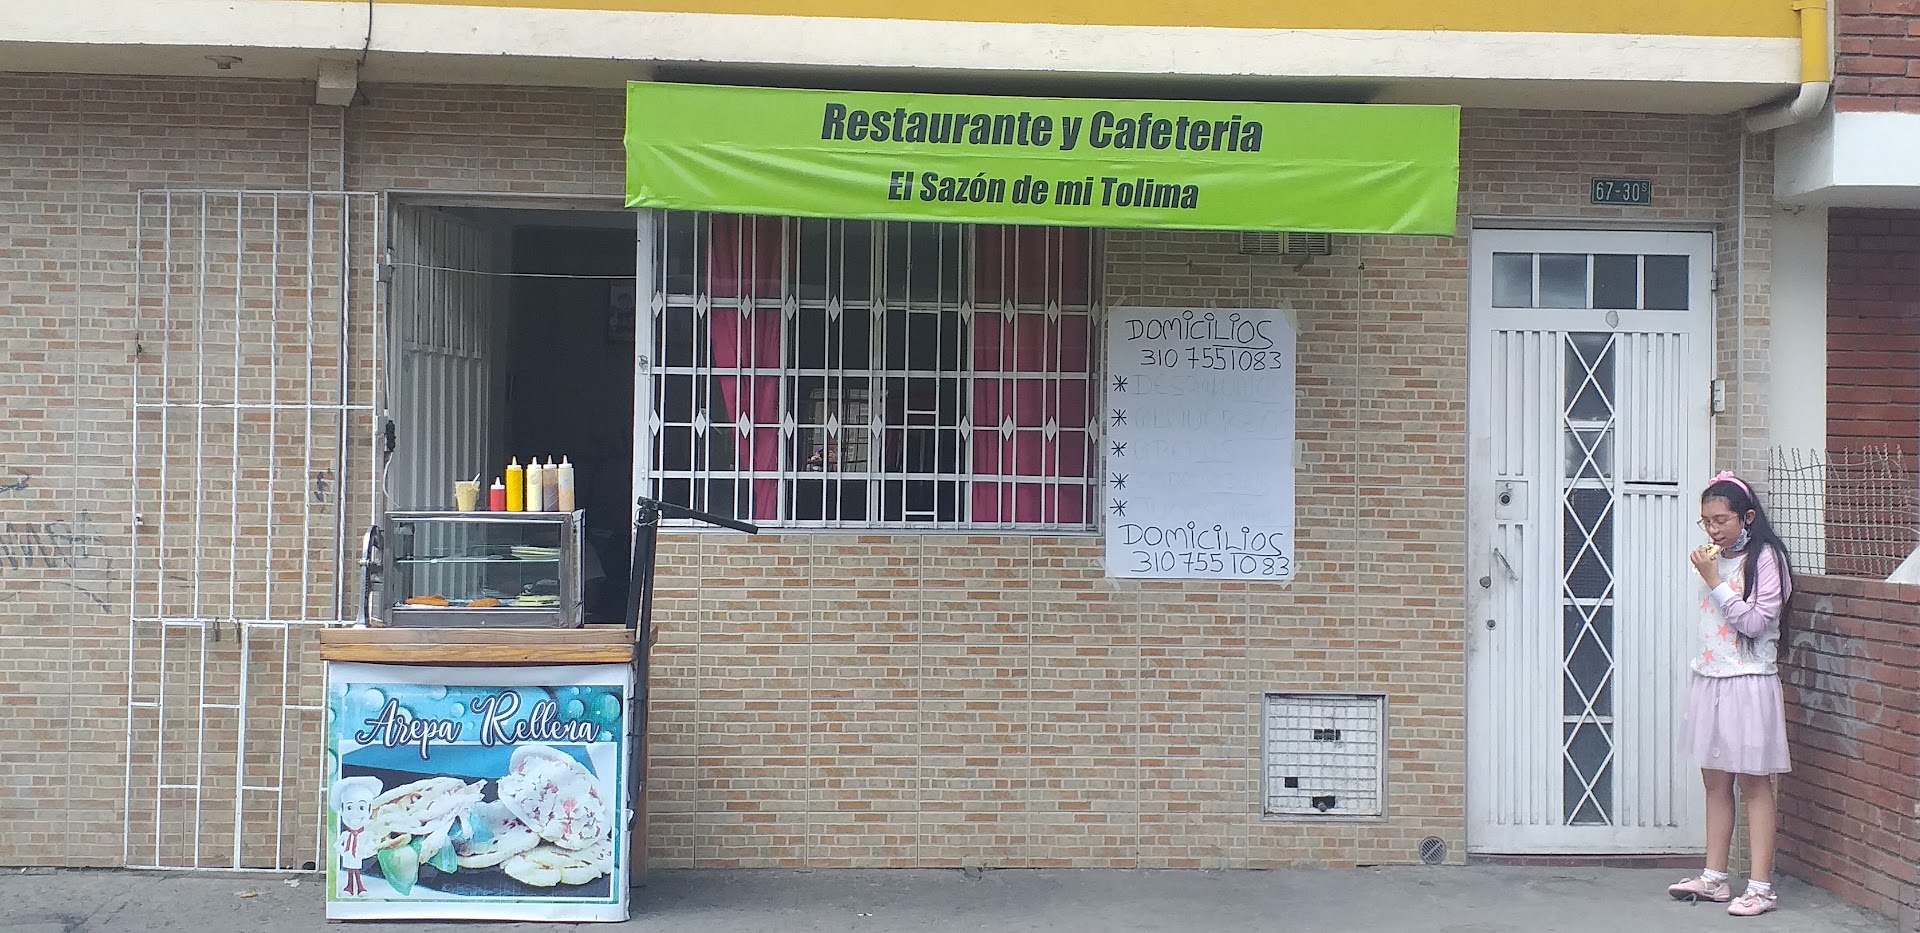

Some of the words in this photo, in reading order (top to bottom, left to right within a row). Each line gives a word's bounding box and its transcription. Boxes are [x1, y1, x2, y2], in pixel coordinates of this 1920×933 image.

[821, 103, 1054, 147] Restaurante
[1059, 116, 1083, 151] y
[1089, 110, 1264, 153] Cafeteria
[887, 171, 915, 200] El
[919, 171, 1005, 204] Sazón
[1011, 175, 1048, 205] de
[1054, 177, 1094, 206] mi
[1100, 177, 1199, 210] Tolima
[355, 698, 463, 761] Arepa
[470, 689, 600, 747] Rellena
